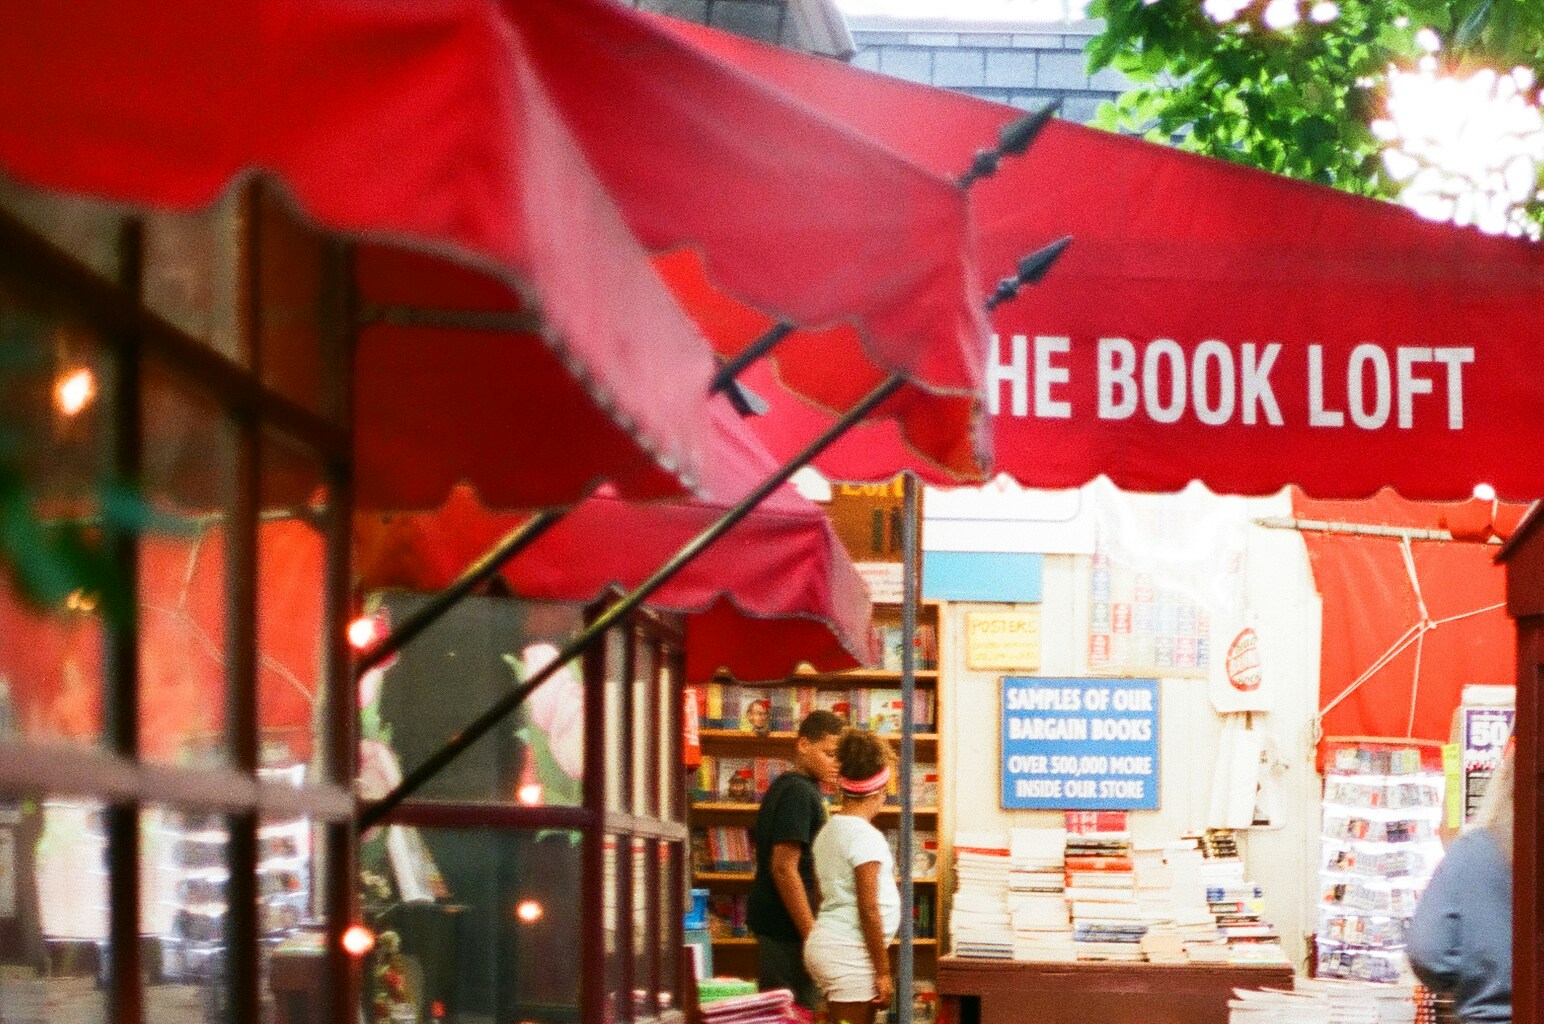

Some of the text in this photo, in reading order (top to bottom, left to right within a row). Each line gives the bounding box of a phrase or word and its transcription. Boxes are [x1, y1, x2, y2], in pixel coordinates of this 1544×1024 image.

[988, 333, 1475, 431] HE BOOK LOFT
[1007, 687, 1153, 712] SAMPLES OF OUR
[1008, 717, 1152, 741] BARGAIN BOOKS
[1008, 755, 1153, 777] OVER 500,000 MORE
[1016, 779, 1144, 799] INSIDE OUR STORE
